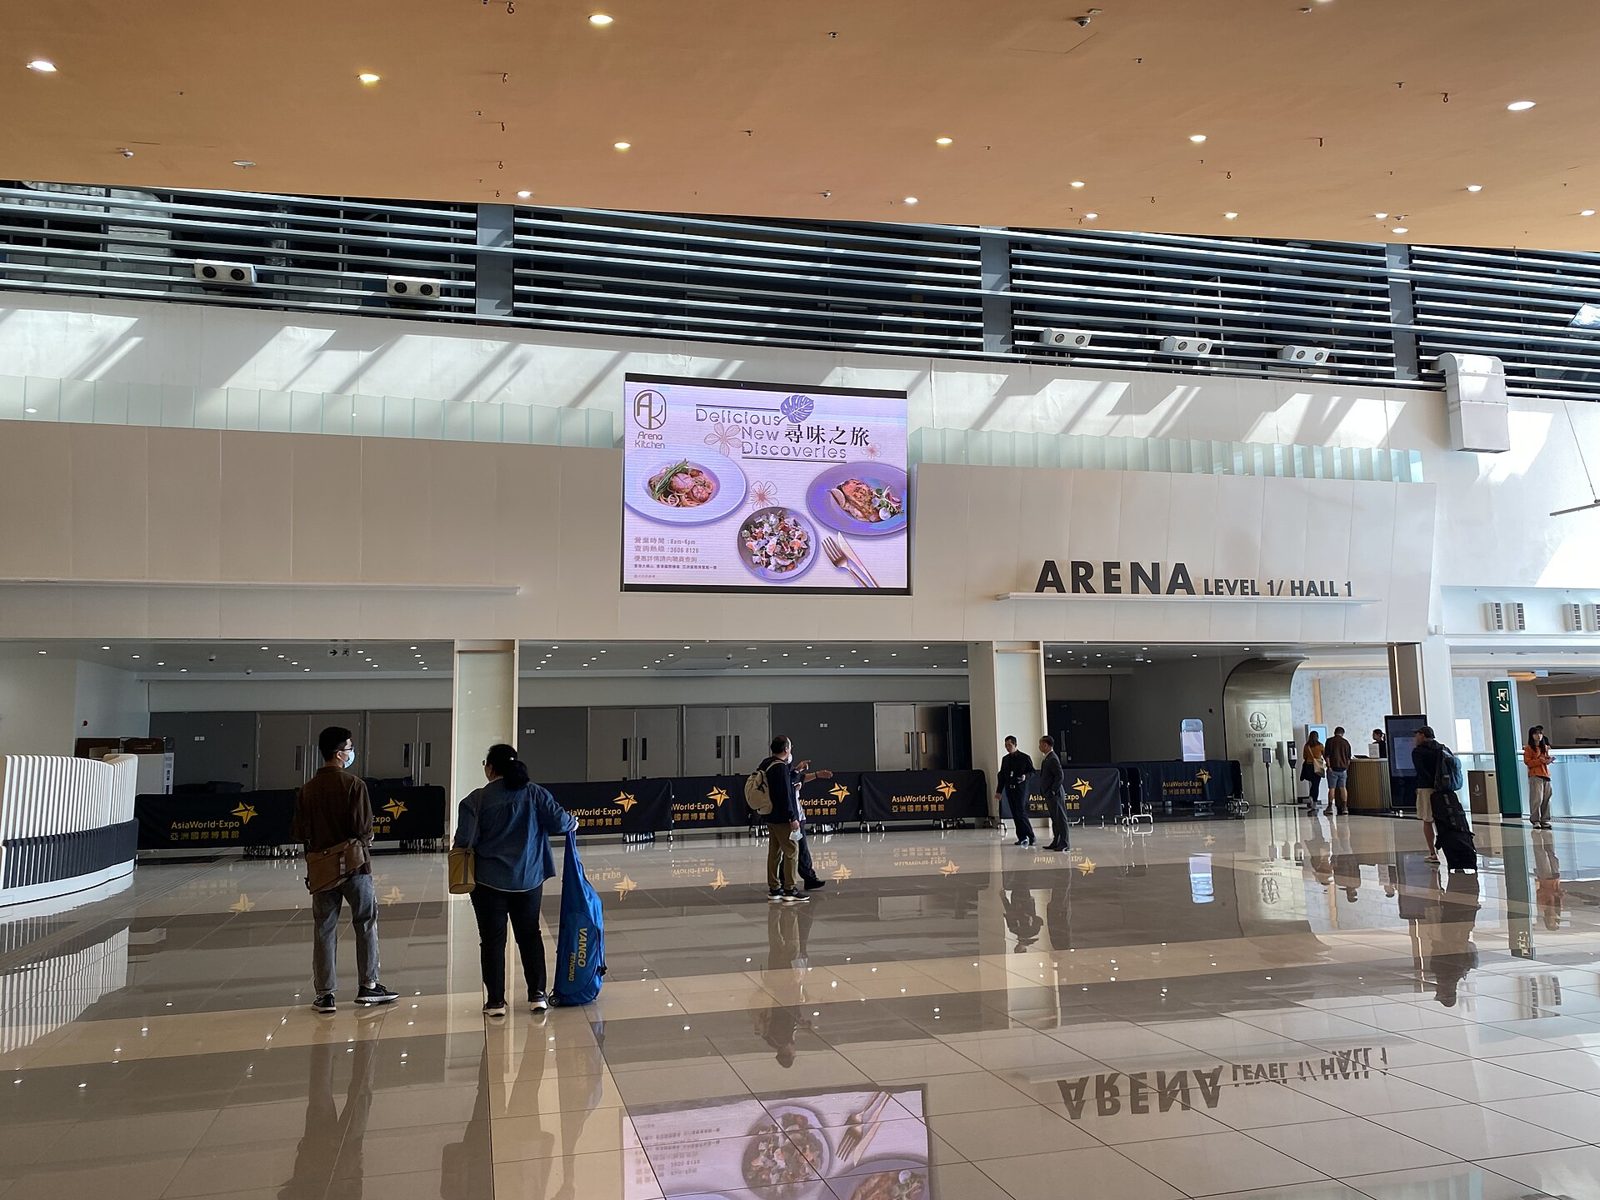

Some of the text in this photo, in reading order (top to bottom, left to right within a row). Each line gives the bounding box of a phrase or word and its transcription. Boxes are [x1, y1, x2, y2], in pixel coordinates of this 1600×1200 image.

[695, 408, 781, 426] Delicious
[637, 430, 663, 440] Arena
[741, 426, 780, 441] New
[784, 424, 871, 447] 尋味之旅
[634, 440, 666, 449] Kitchen
[741, 441, 848, 459] Discoveries
[1035, 560, 1352, 597] ARENA LEVEL 1/ HALL 1
[891, 795, 944, 803] AsiaWorld-Expo
[171, 819, 240, 831] AsiaWorld-Expo
[577, 927, 588, 968] VANGO
